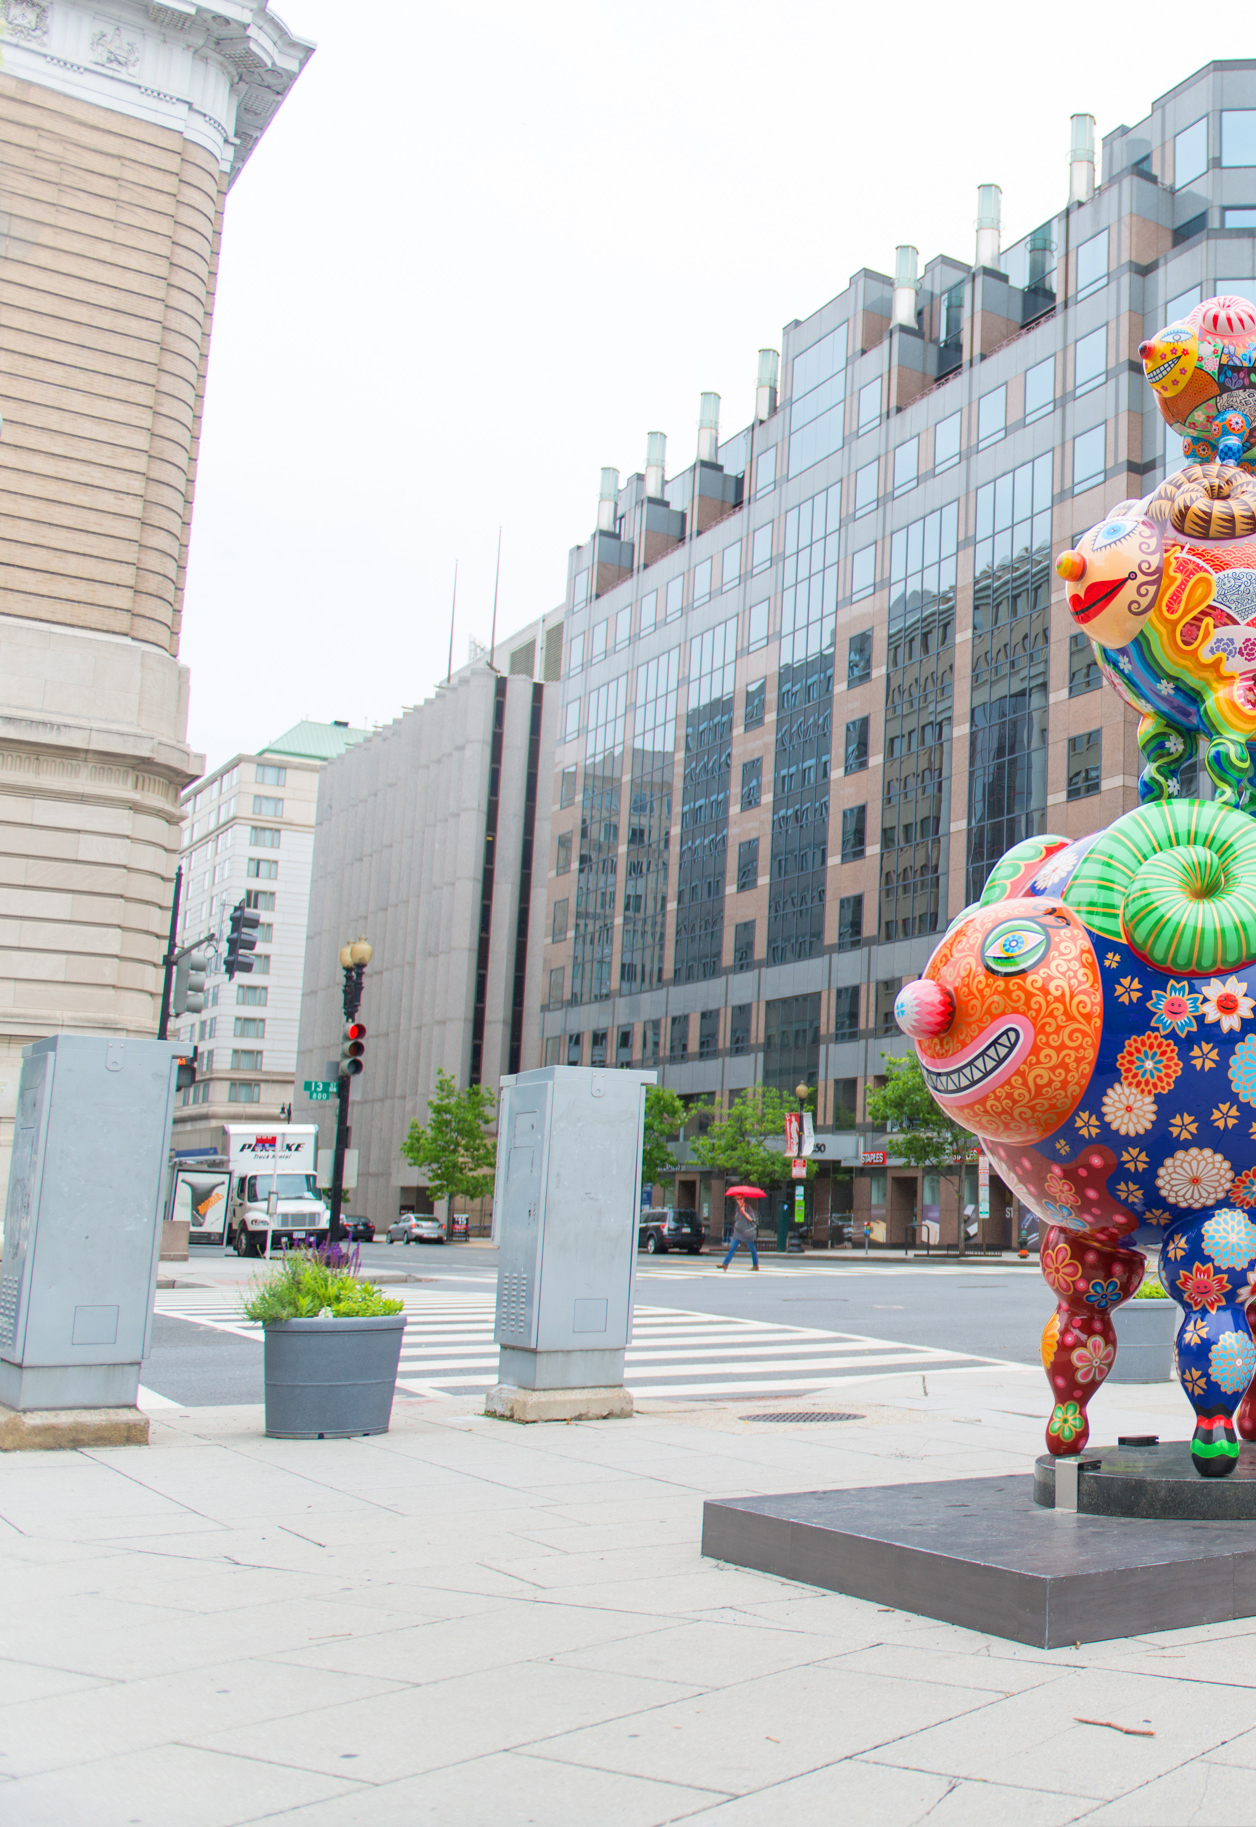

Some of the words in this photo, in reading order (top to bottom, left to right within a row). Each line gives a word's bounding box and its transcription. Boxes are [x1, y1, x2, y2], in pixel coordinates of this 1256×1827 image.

[311, 1082, 323, 1091] 13
[312, 1092, 327, 1100] 800
[861, 1152, 884, 1163] STAPLES
